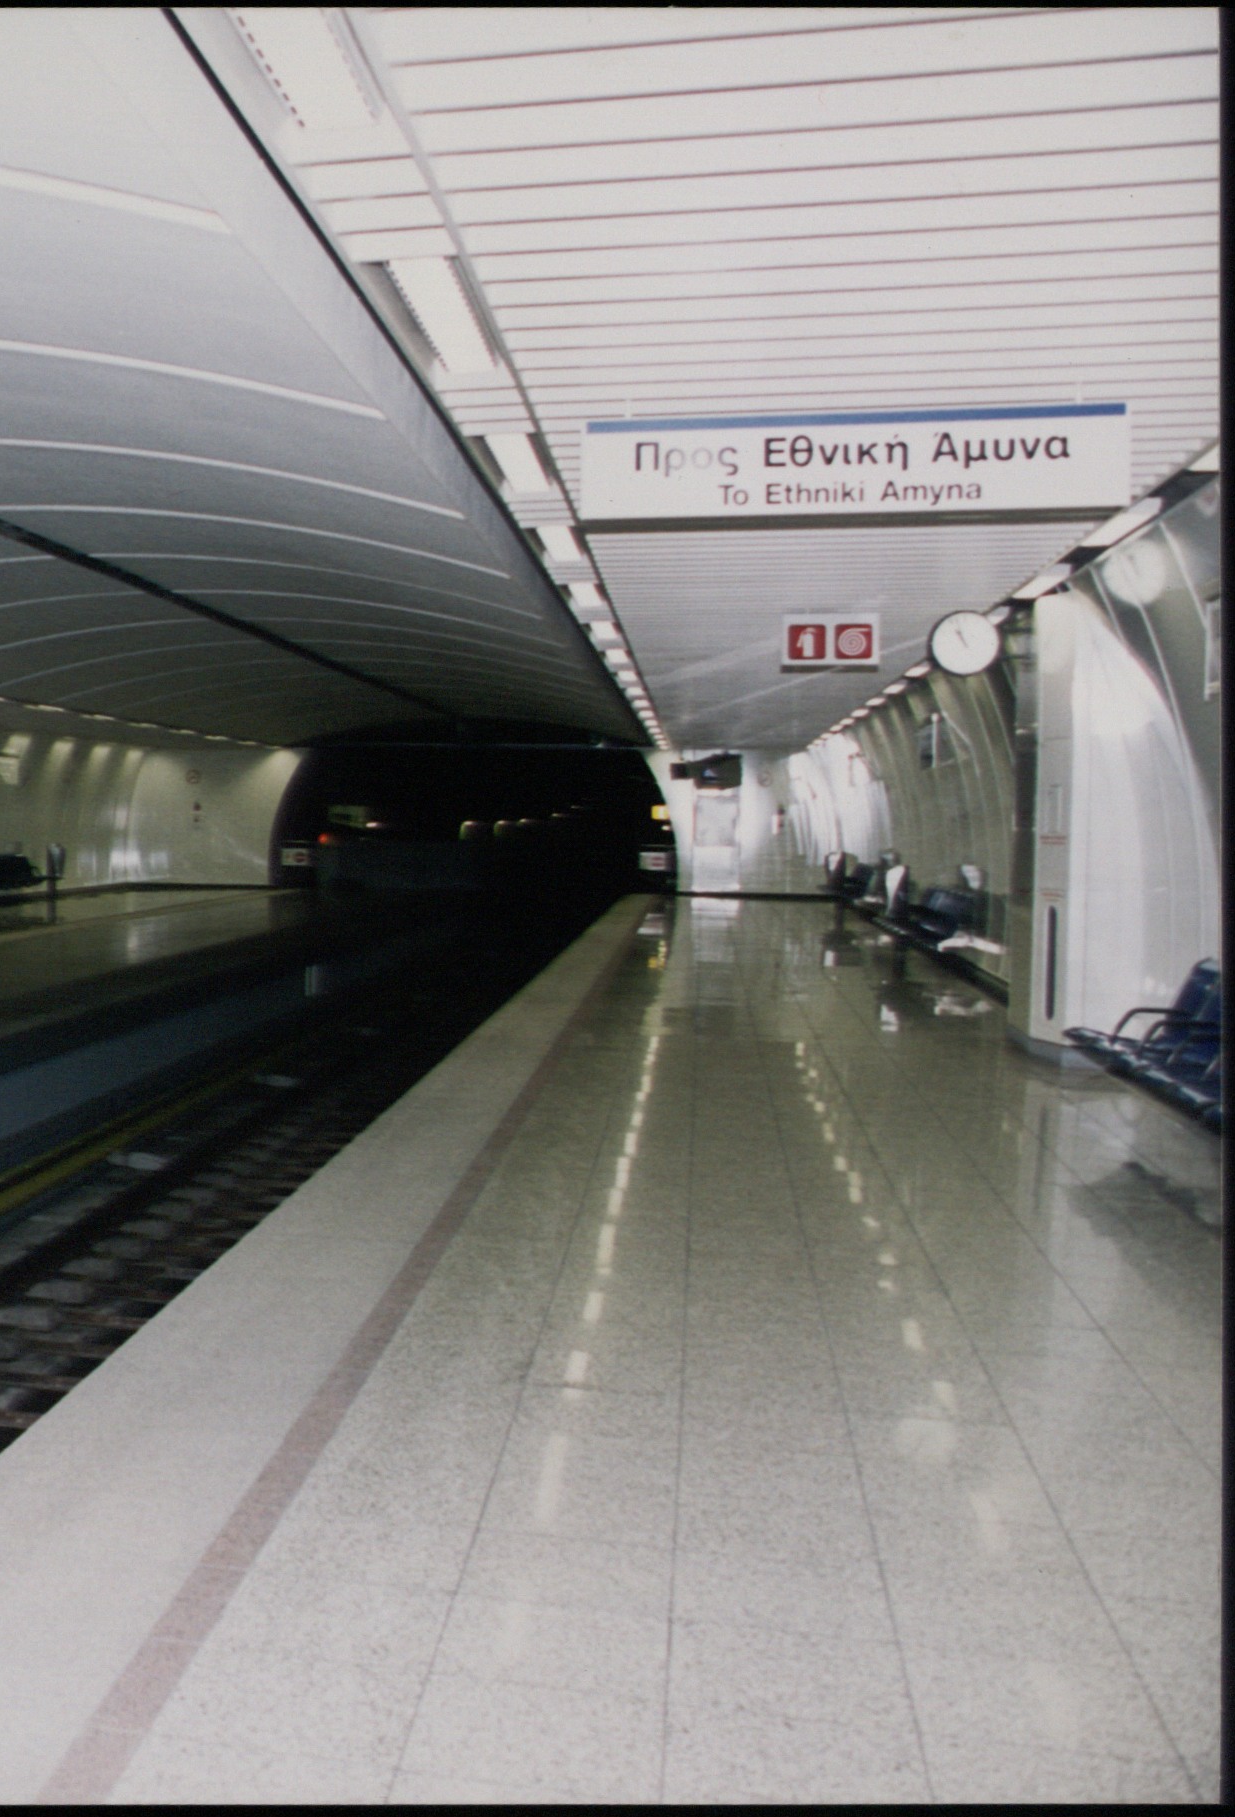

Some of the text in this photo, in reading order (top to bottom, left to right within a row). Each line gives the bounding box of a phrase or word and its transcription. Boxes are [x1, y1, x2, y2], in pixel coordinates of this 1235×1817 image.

[634, 431, 1071, 478] Προς Εθνική Άμυνα
[718, 479, 983, 507] To Ethniki Amyna
